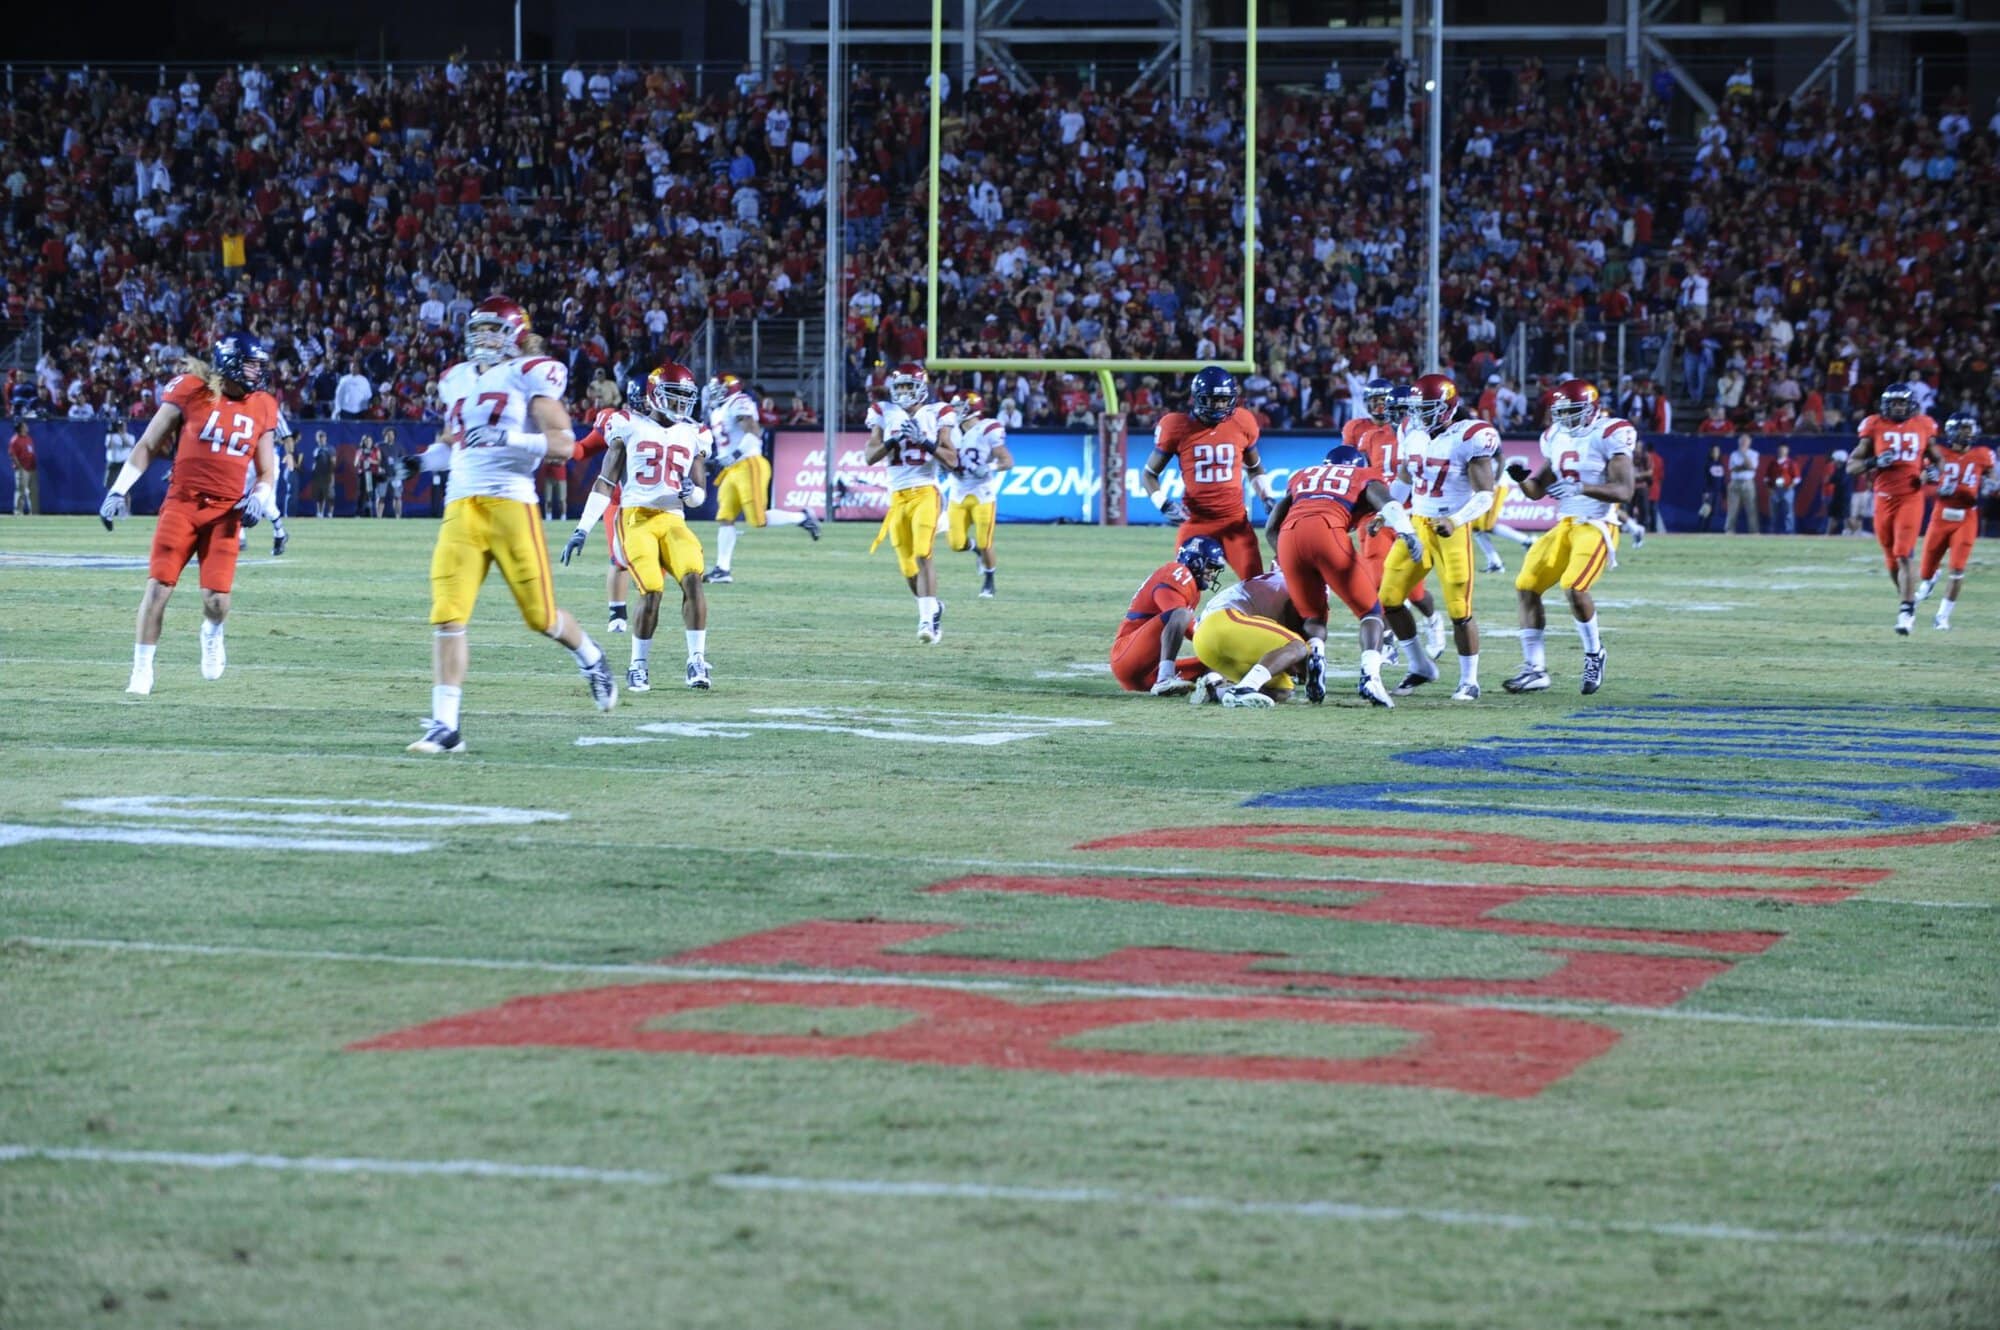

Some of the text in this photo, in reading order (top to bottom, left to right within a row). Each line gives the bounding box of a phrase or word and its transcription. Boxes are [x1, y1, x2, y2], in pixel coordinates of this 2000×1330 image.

[199, 410, 255, 457] 42
[1883, 431, 1920, 462] 33
[636, 440, 690, 489] 36
[1106, 418, 1125, 519] WILDCATS
[1193, 443, 1235, 483] 29
[1302, 466, 1356, 497] 35
[1408, 454, 1451, 498] 37
[1172, 567, 1194, 586] 47
[354, 822, 1999, 1098] BEAR
